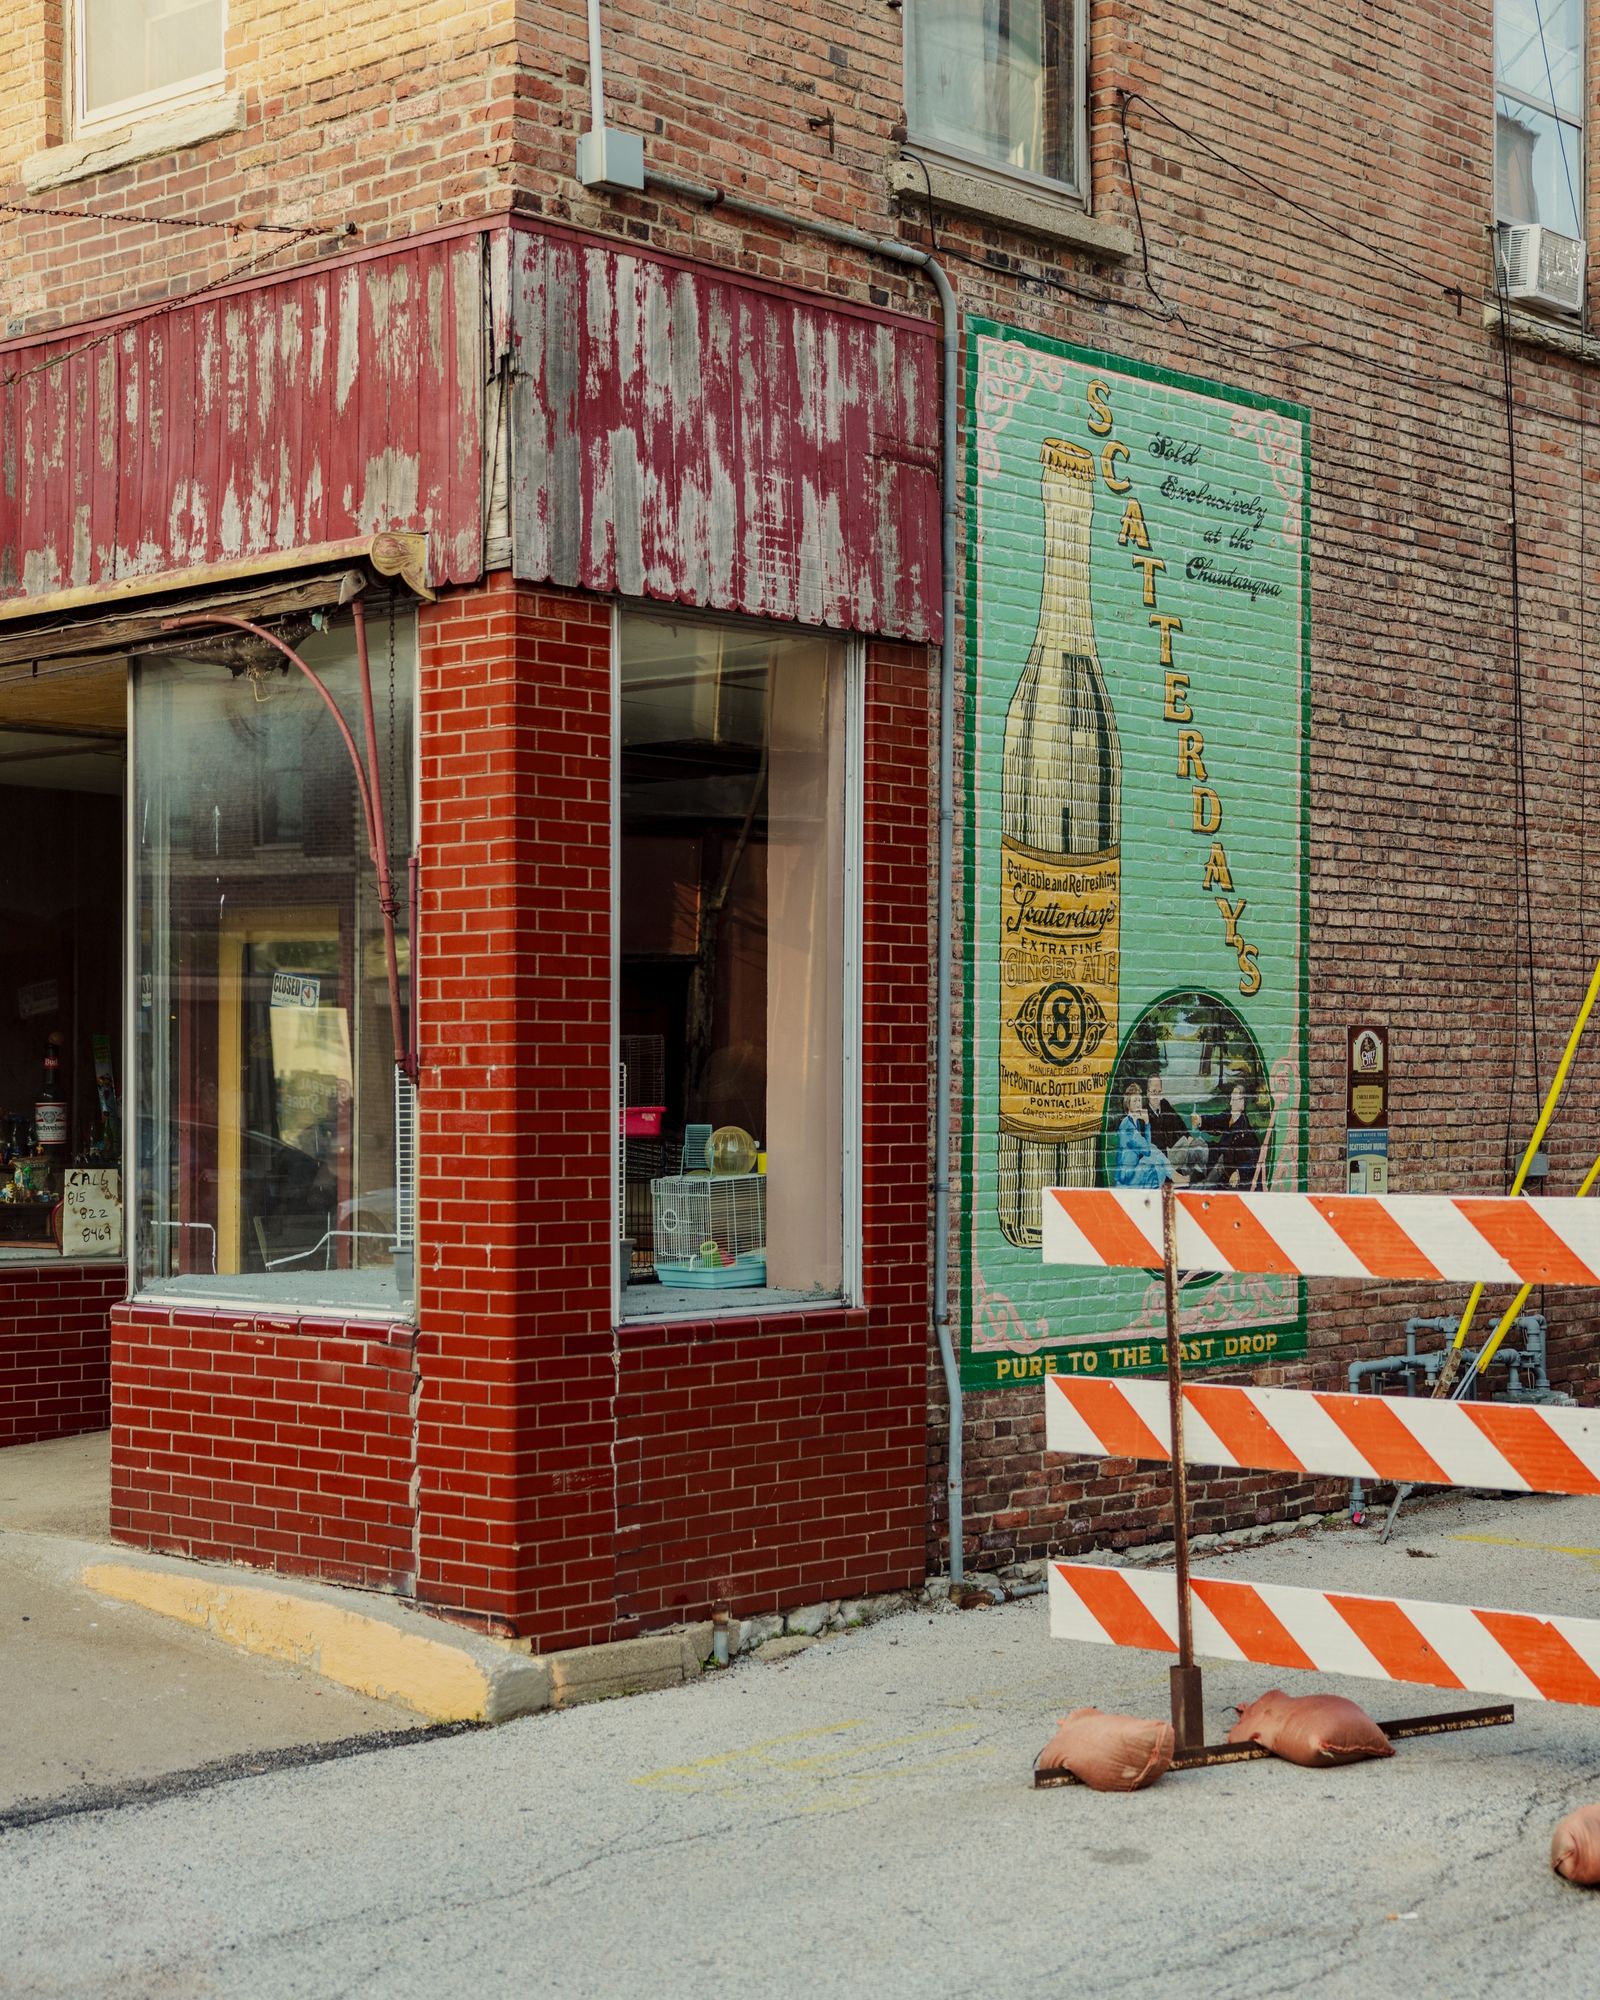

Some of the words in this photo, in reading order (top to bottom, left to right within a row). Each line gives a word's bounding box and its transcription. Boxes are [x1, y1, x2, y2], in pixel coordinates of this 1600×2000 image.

[1148, 432, 1201, 466] Sold
[1160, 475, 1268, 531] Exclusively
[1203, 526, 1222, 544] at
[1229, 527, 1254, 551] the
[1186, 556, 1282, 601] Chautauqua
[1007, 858, 1051, 890] Palatable
[1052, 874, 1068, 892] and
[1069, 871, 1117, 898] Refreshing
[1021, 937, 1067, 955] EXTRA
[1072, 941, 1103, 955] FINE
[1004, 947, 1076, 989] GINGER
[1081, 951, 1117, 990] ALE
[273, 974, 301, 997] CLOSED
[44, 1057, 58, 1066] Bud
[1028, 1064, 1079, 1076] MANUFACTURED
[1082, 1062, 1092, 1073] BY
[1001, 1065, 1013, 1087] THE
[1013, 1070, 1047, 1096] PONTIAC
[1048, 1079, 1092, 1097] BOTTLING
[1022, 1107, 1055, 1119] CONTENTS
[1074, 1097, 1090, 1106] ILL.
[67, 1191, 86, 1205] 815
[80, 1207, 108, 1219] 822
[82, 1223, 111, 1242] 8469
[996, 1354, 1057, 1379] PURE
[1068, 1351, 1098, 1372] TO
[1108, 1345, 1152, 1369] THE
[1225, 1332, 1278, 1356] DROP
